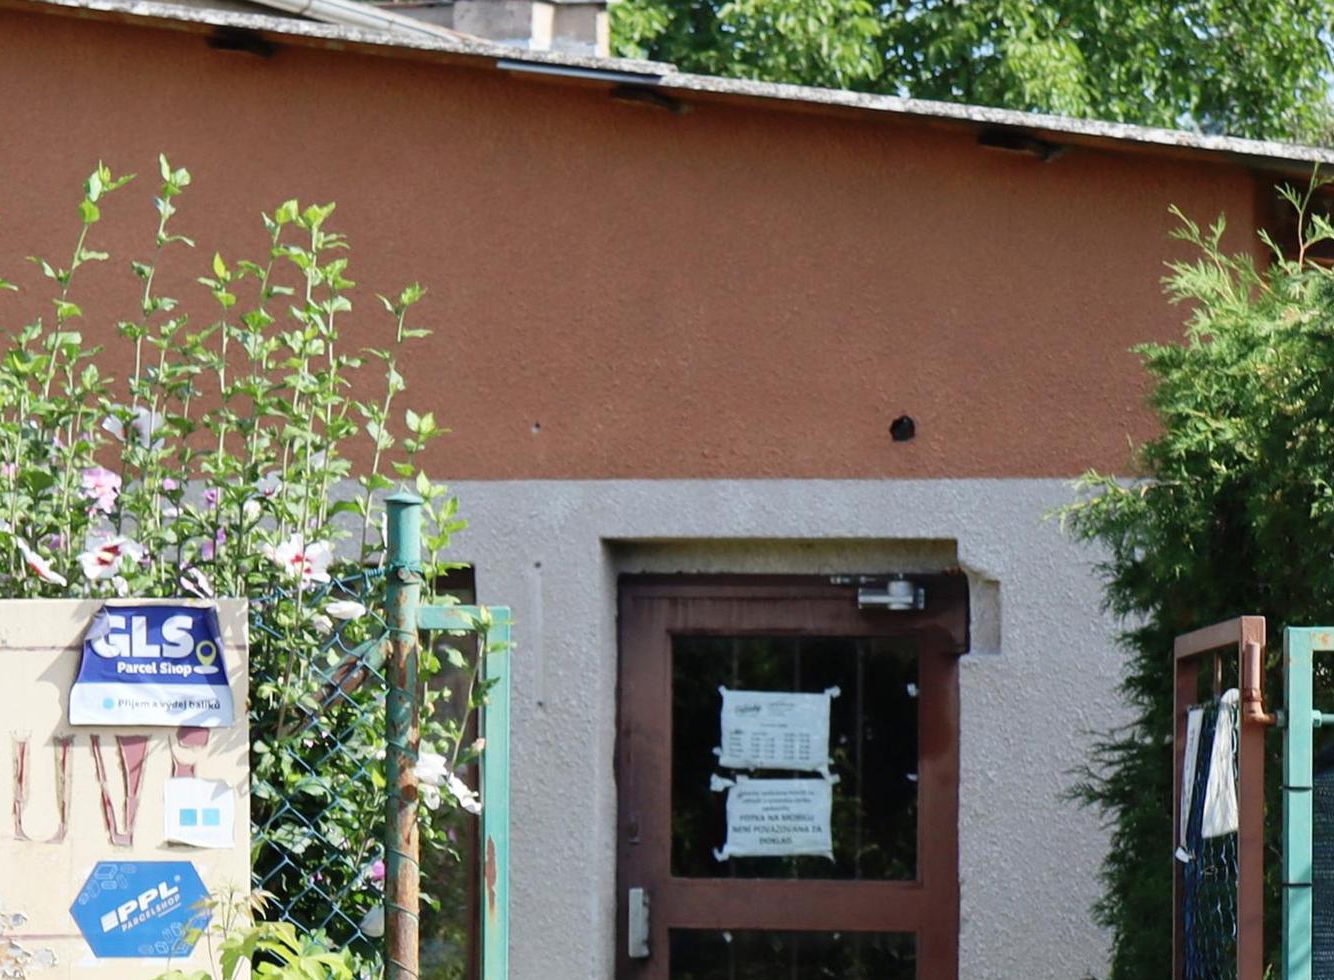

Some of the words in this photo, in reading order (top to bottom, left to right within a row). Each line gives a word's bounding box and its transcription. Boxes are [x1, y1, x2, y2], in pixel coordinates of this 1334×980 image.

[91, 615, 194, 658] GLS
[117, 661, 157, 675] Parcel
[160, 662, 192, 678] Shop
[117, 881, 180, 923] PPL
